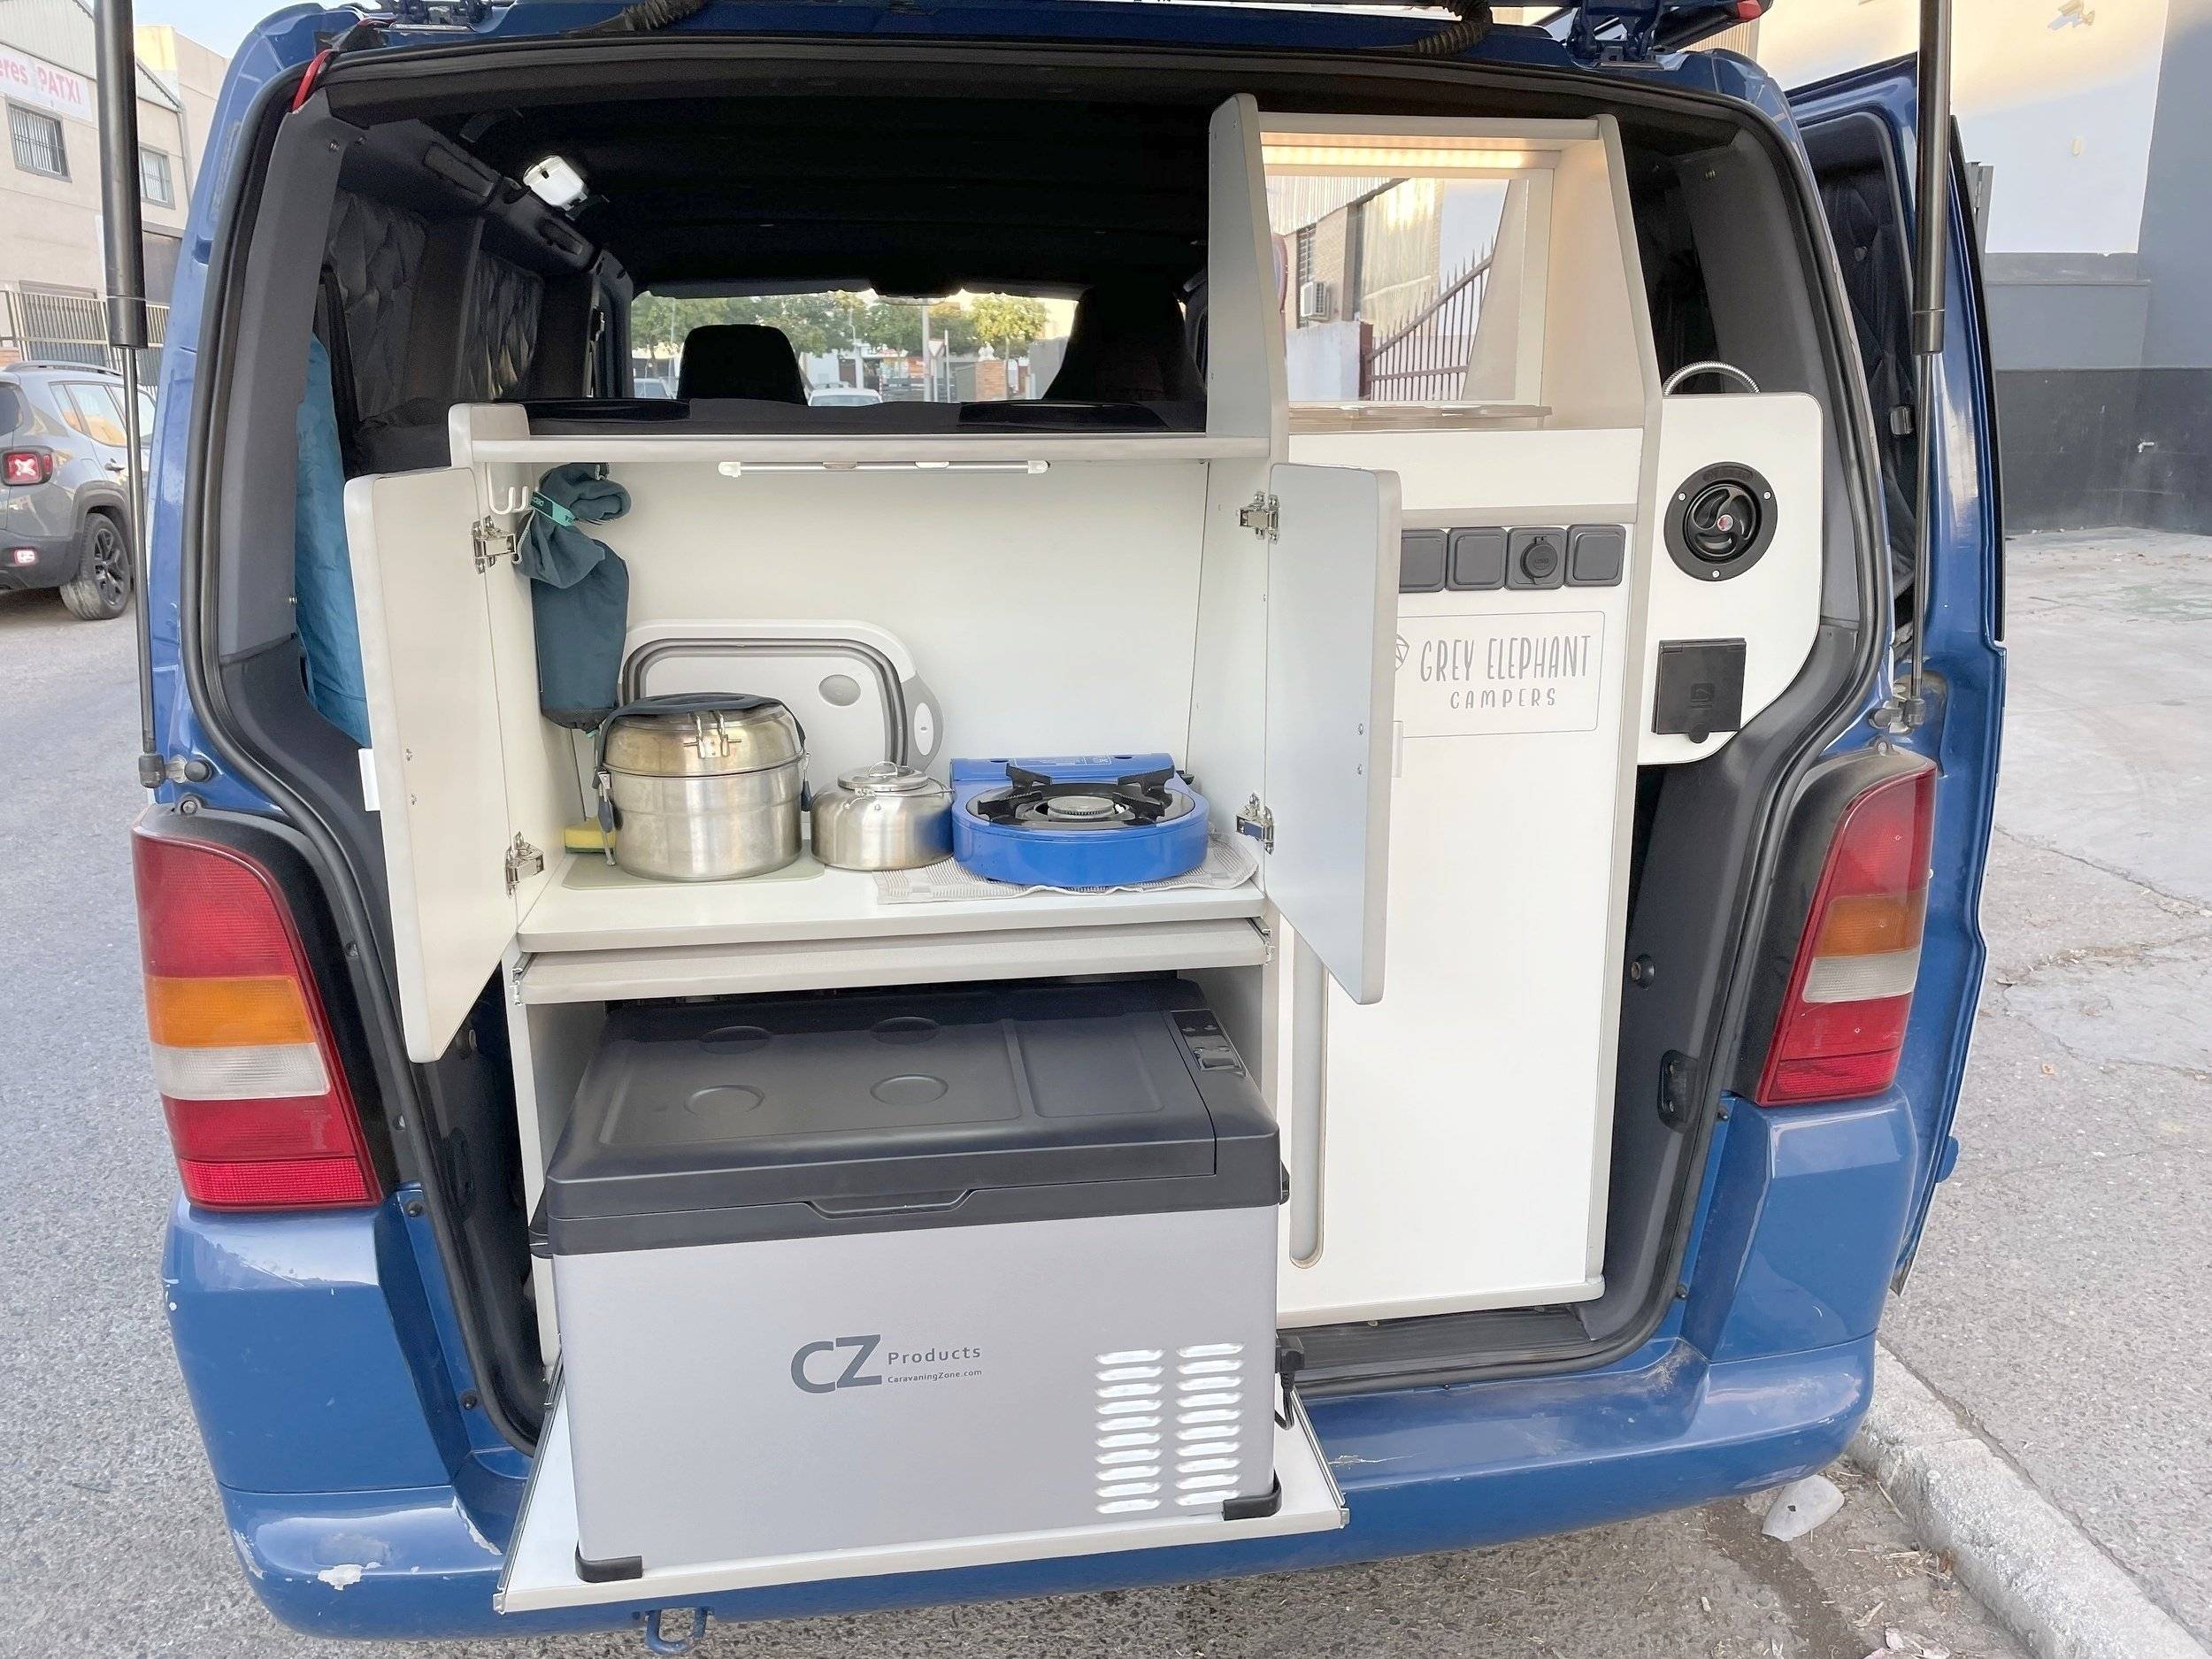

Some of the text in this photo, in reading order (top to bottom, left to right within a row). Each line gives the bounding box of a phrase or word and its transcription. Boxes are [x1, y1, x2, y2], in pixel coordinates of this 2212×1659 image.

[1420, 635, 1591, 682] GREY ELEPHANT
[1450, 687, 1556, 710] CAMPERS
[790, 1333, 981, 1394] CZ Products
[887, 1369, 982, 1384] CaravaningZone.com
